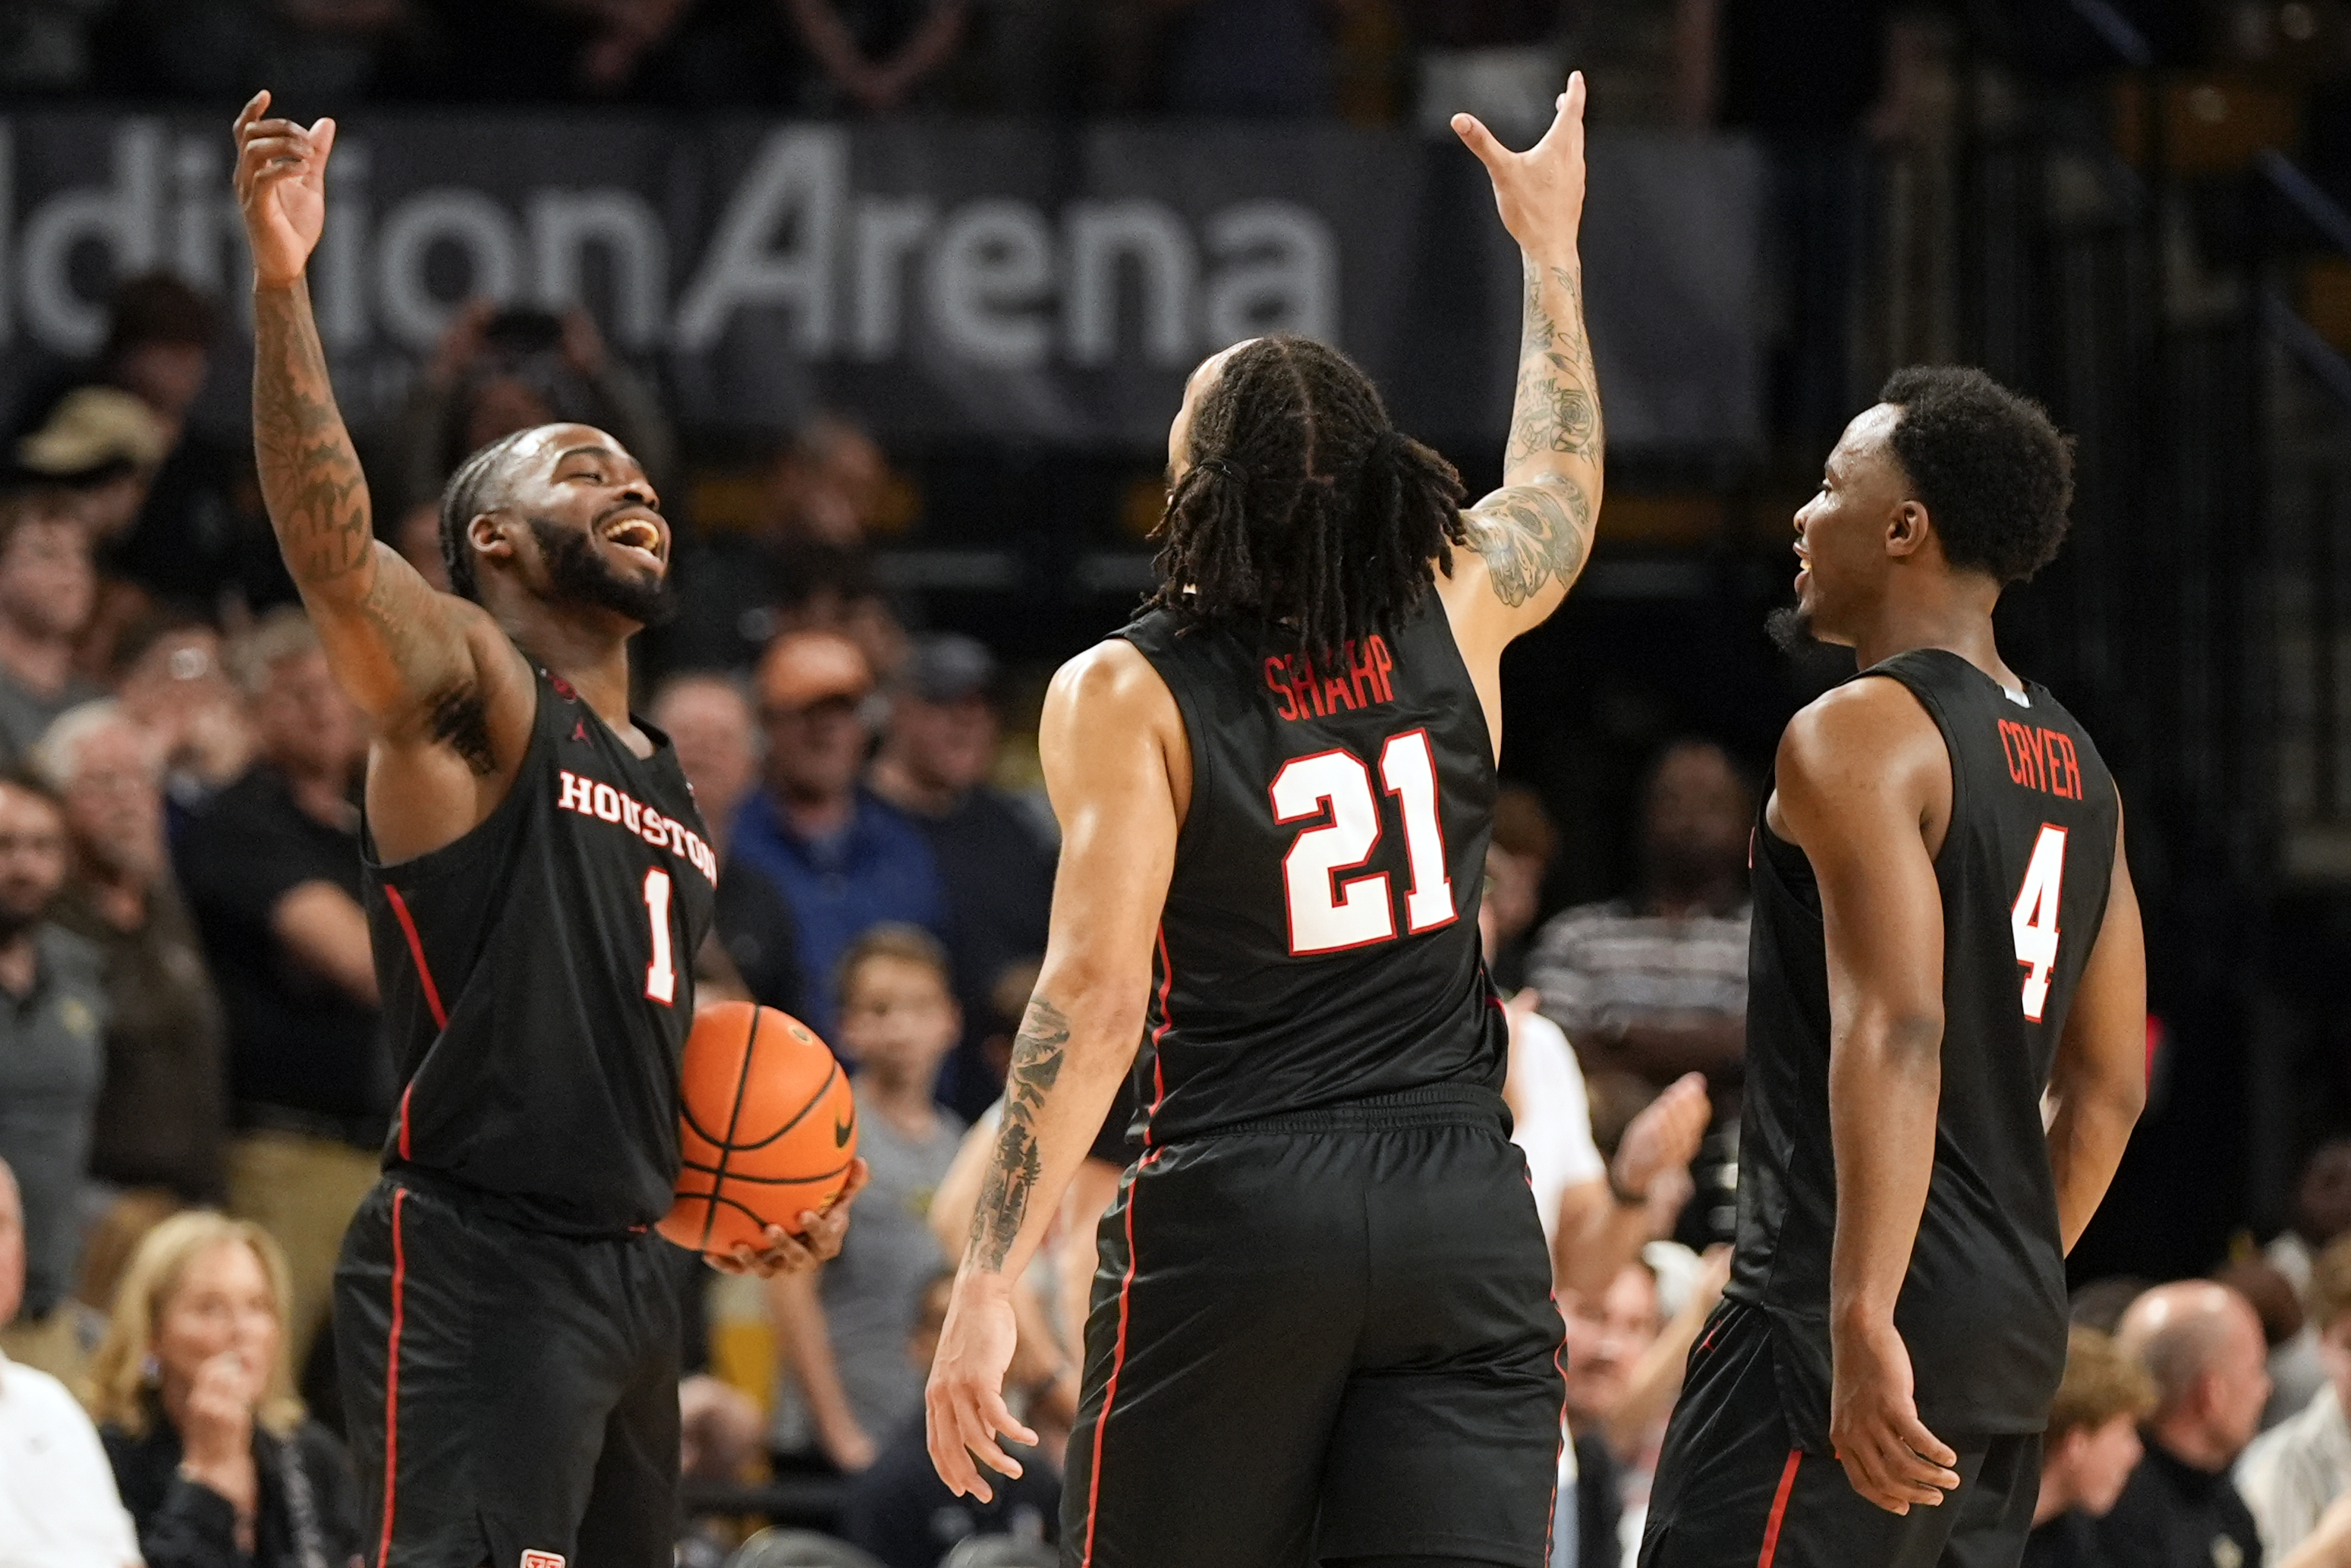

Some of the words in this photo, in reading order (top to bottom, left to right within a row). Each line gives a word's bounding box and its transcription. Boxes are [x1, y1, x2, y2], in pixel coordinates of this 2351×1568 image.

[558, 769, 719, 889] HOUSTON
[1997, 718, 2082, 800] CRYER
[1267, 726, 1459, 956] 21
[642, 865, 676, 1007] 1
[2011, 821, 2068, 1025] 4
